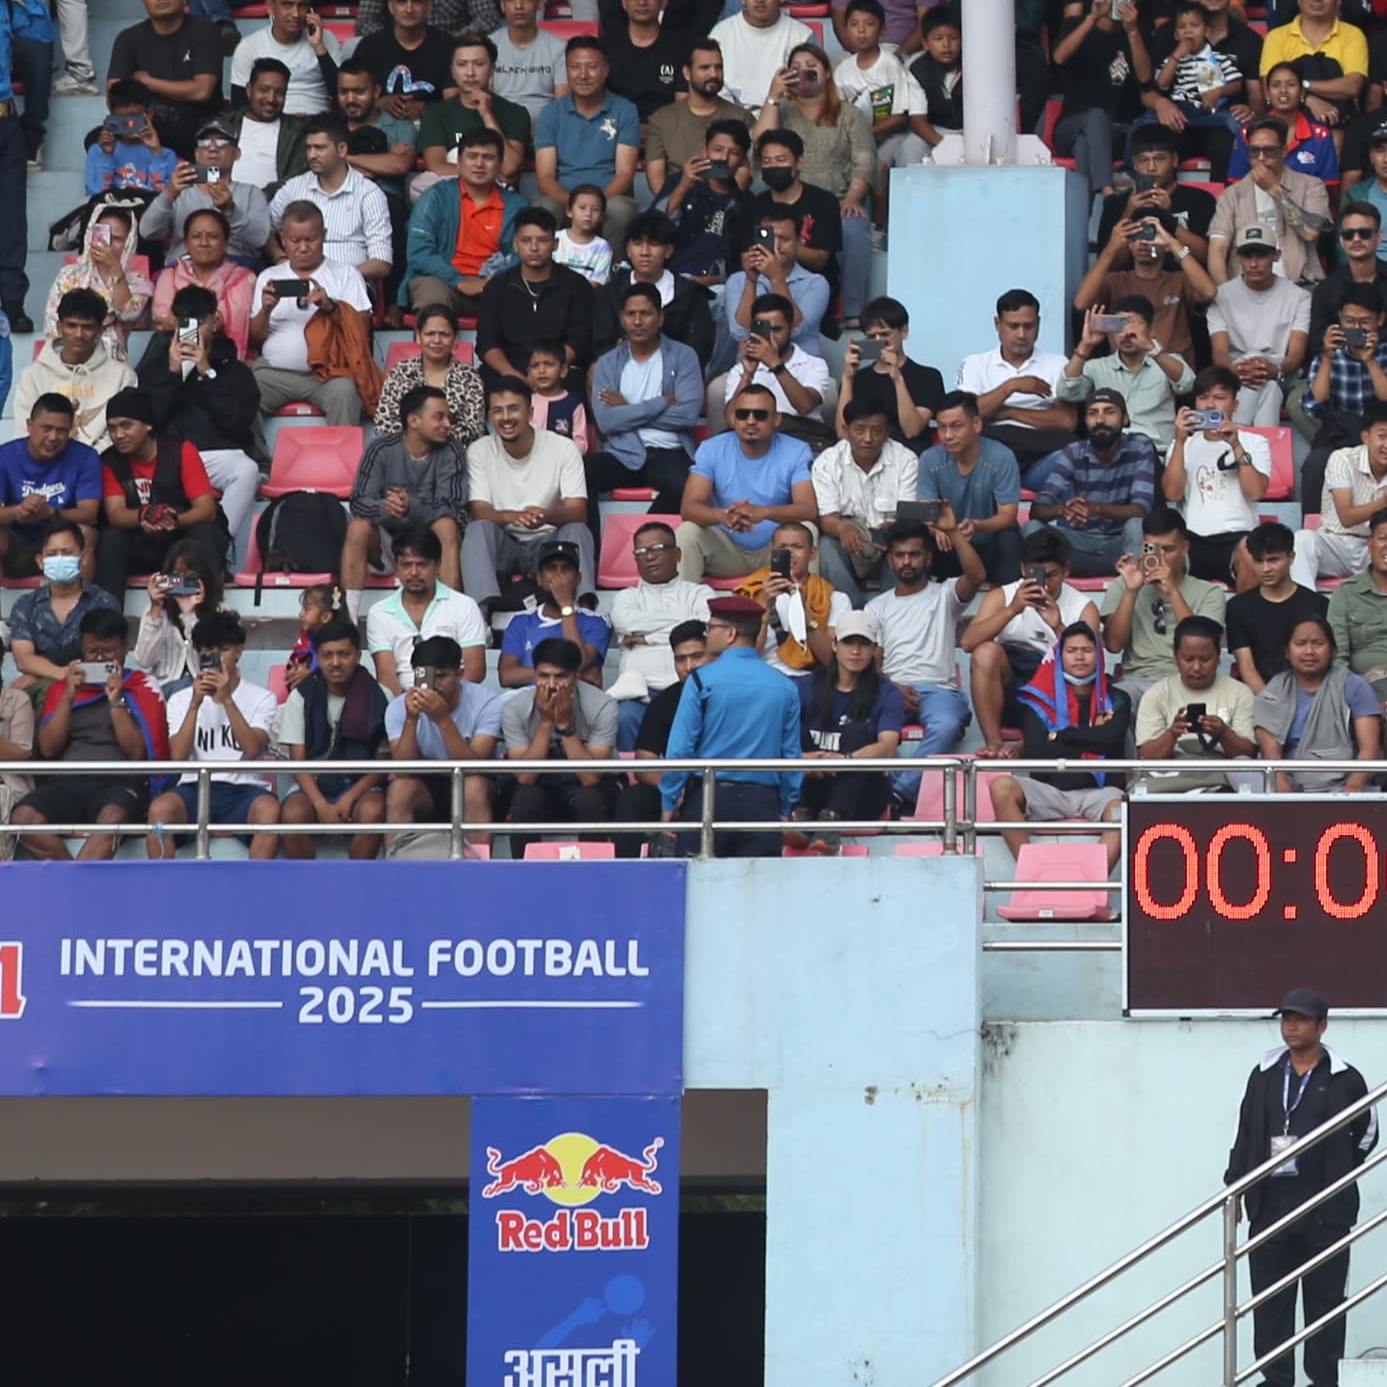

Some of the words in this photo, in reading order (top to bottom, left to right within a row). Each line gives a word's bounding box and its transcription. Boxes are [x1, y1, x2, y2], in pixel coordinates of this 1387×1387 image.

[59, 938, 414, 977] INTERNATIONAL
[427, 938, 650, 977] FOOTBALL
[298, 985, 415, 1024] 2025
